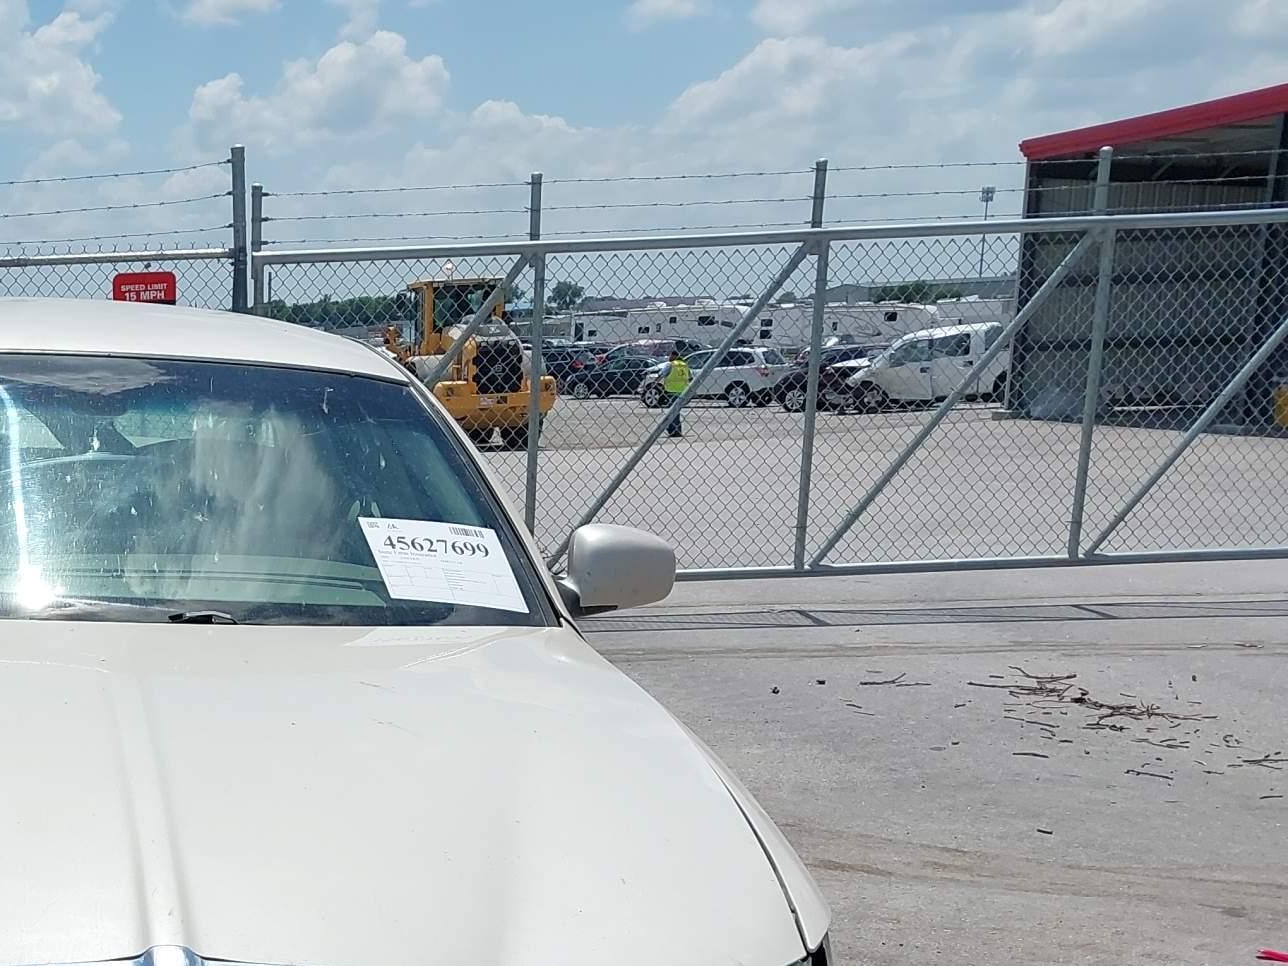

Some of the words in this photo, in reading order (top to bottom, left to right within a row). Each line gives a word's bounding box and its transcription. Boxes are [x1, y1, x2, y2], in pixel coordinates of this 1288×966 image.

[120, 284, 146, 292] SPEED
[147, 283, 168, 291] LIMIT
[124, 291, 137, 301] 15
[140, 290, 165, 300] MPH
[383, 535, 490, 558] 45627699
